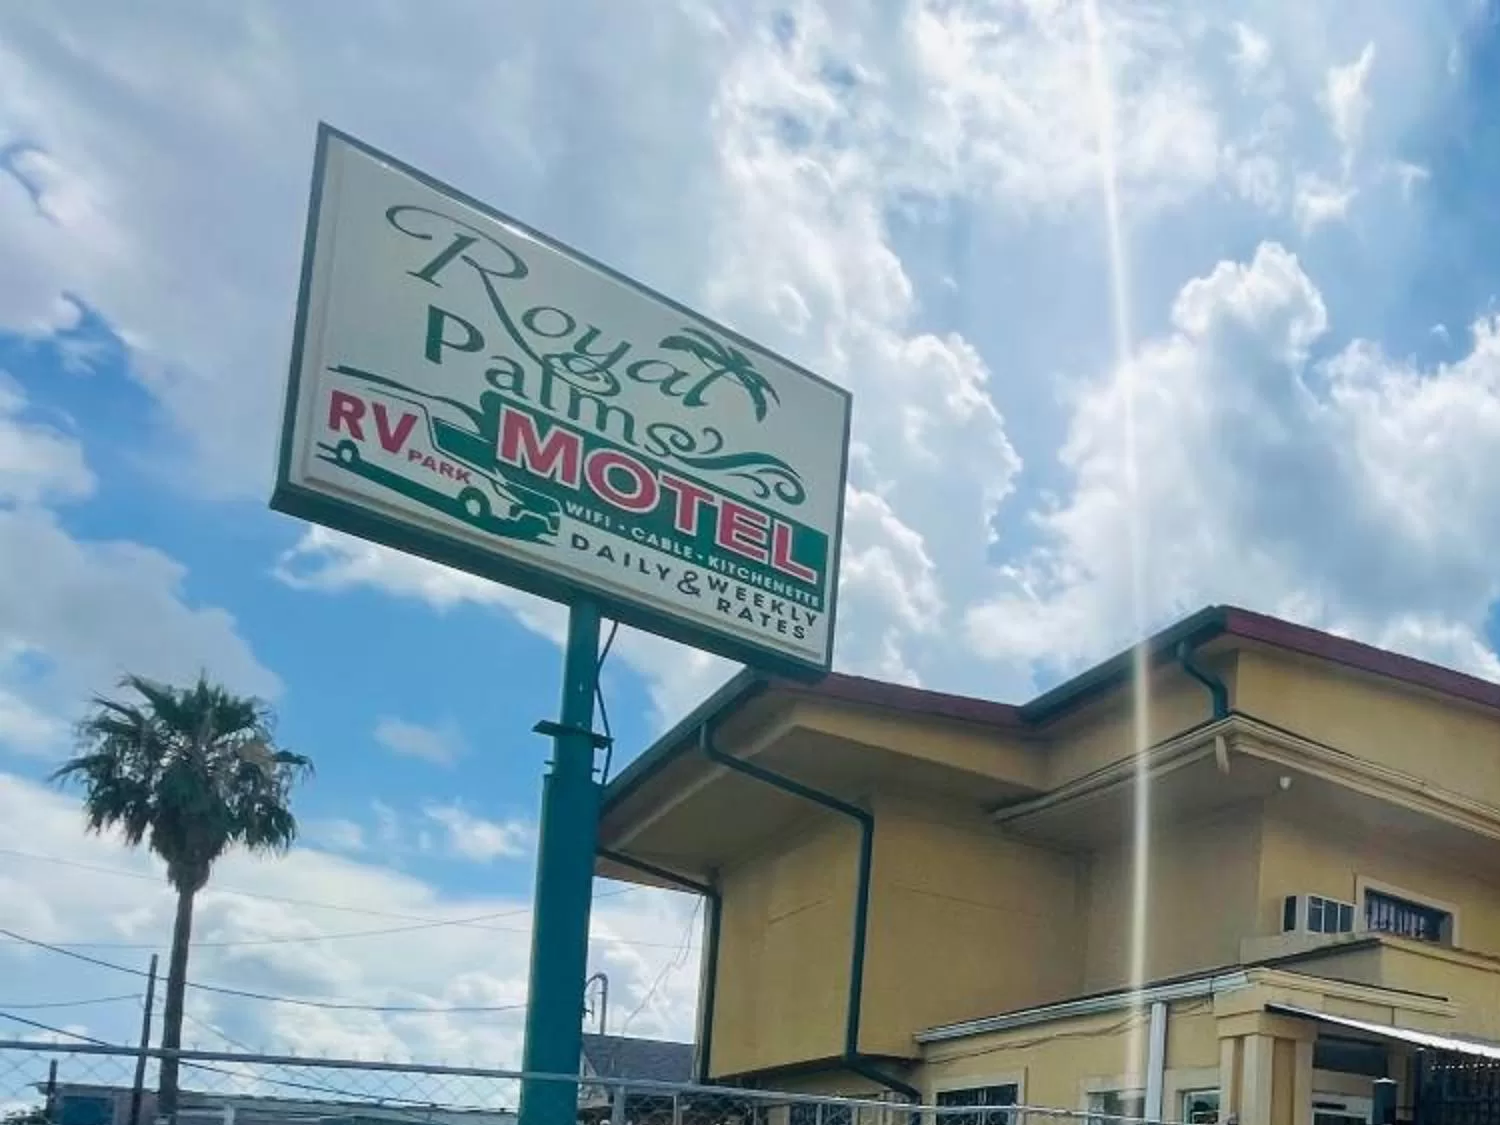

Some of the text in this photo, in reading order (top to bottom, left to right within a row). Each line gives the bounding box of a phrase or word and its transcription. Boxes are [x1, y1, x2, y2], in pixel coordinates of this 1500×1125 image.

[385, 205, 781, 421] Royal
[424, 303, 696, 457] Palms
[327, 389, 418, 455] RV
[406, 449, 474, 485] PARK
[497, 402, 817, 584] MOTEL
[565, 500, 612, 528] WIFI
[631, 526, 694, 559] CABLE
[571, 533, 818, 627] DAILY & WEEKLY
[717, 598, 806, 640] RATES
